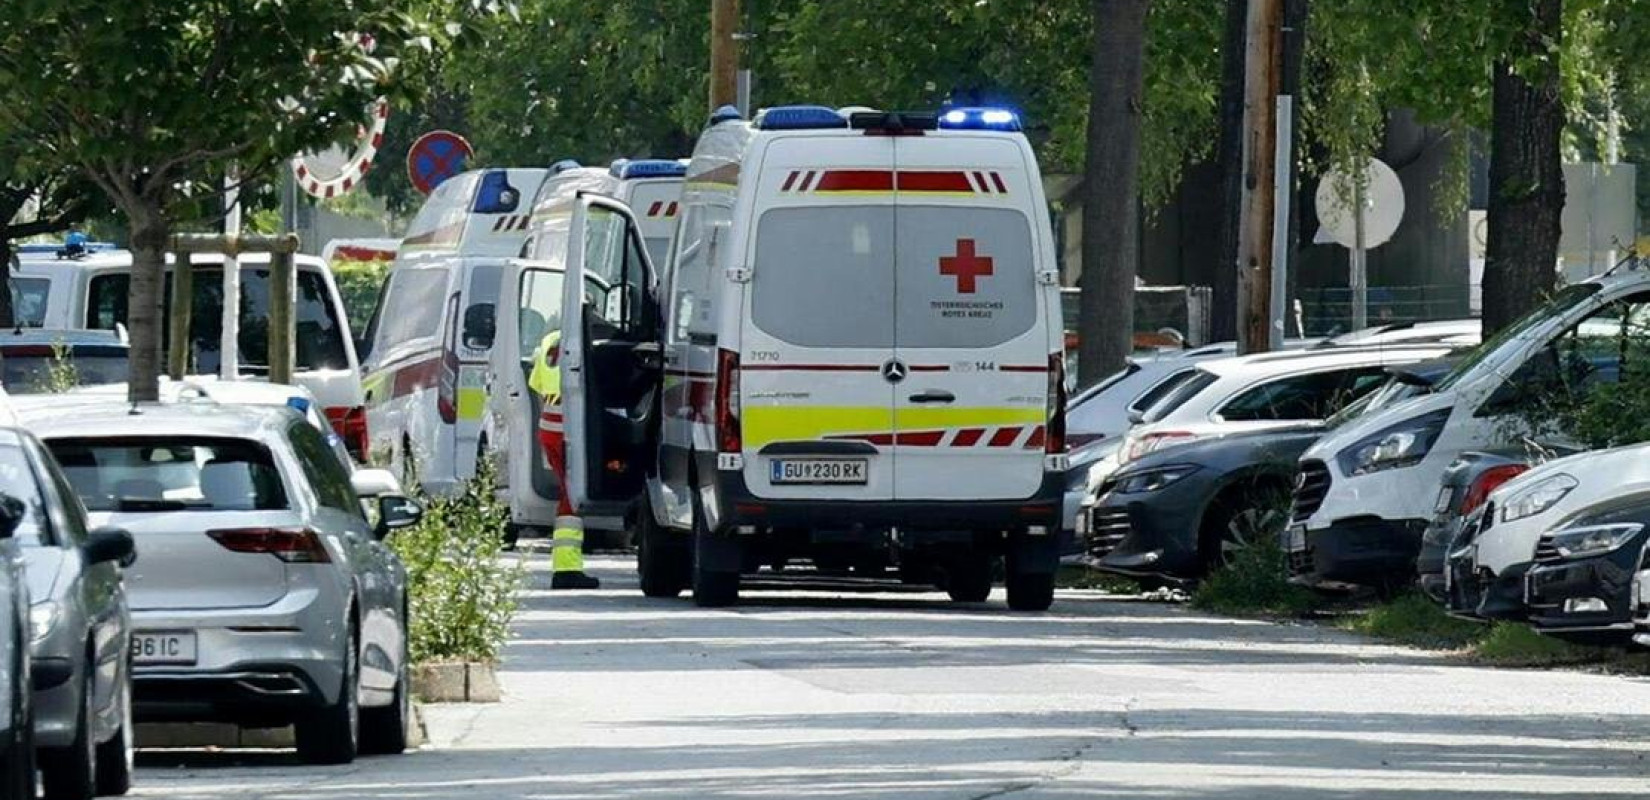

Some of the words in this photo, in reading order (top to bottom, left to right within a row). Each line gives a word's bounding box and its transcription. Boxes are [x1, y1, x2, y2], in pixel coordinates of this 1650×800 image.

[975, 361, 994, 371] 144
[785, 463, 803, 478] GU
[813, 463, 840, 478] 230
[843, 463, 862, 478] RK
[161, 637, 179, 657] IC
